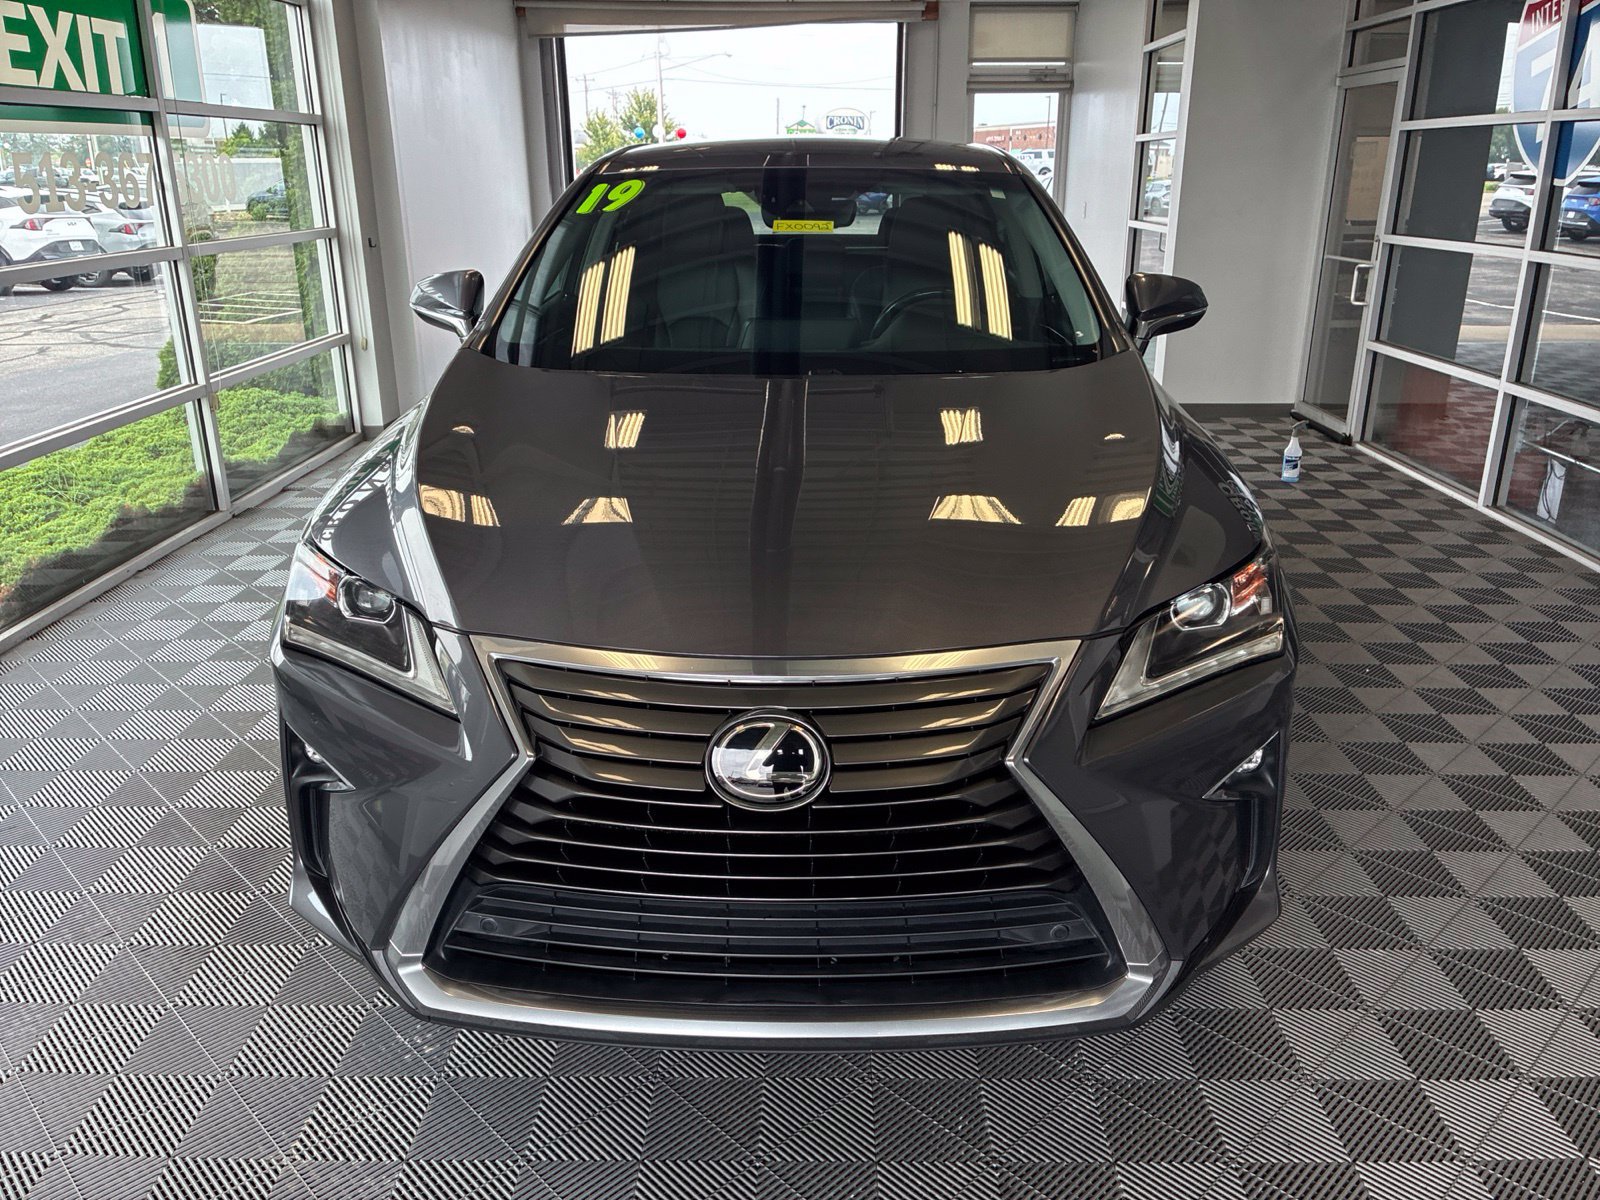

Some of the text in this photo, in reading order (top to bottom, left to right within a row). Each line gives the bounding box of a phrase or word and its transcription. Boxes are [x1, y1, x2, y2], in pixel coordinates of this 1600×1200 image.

[0, 0, 126, 96] EXIT
[827, 116, 864, 129] CRONIN
[576, 179, 645, 214] 19
